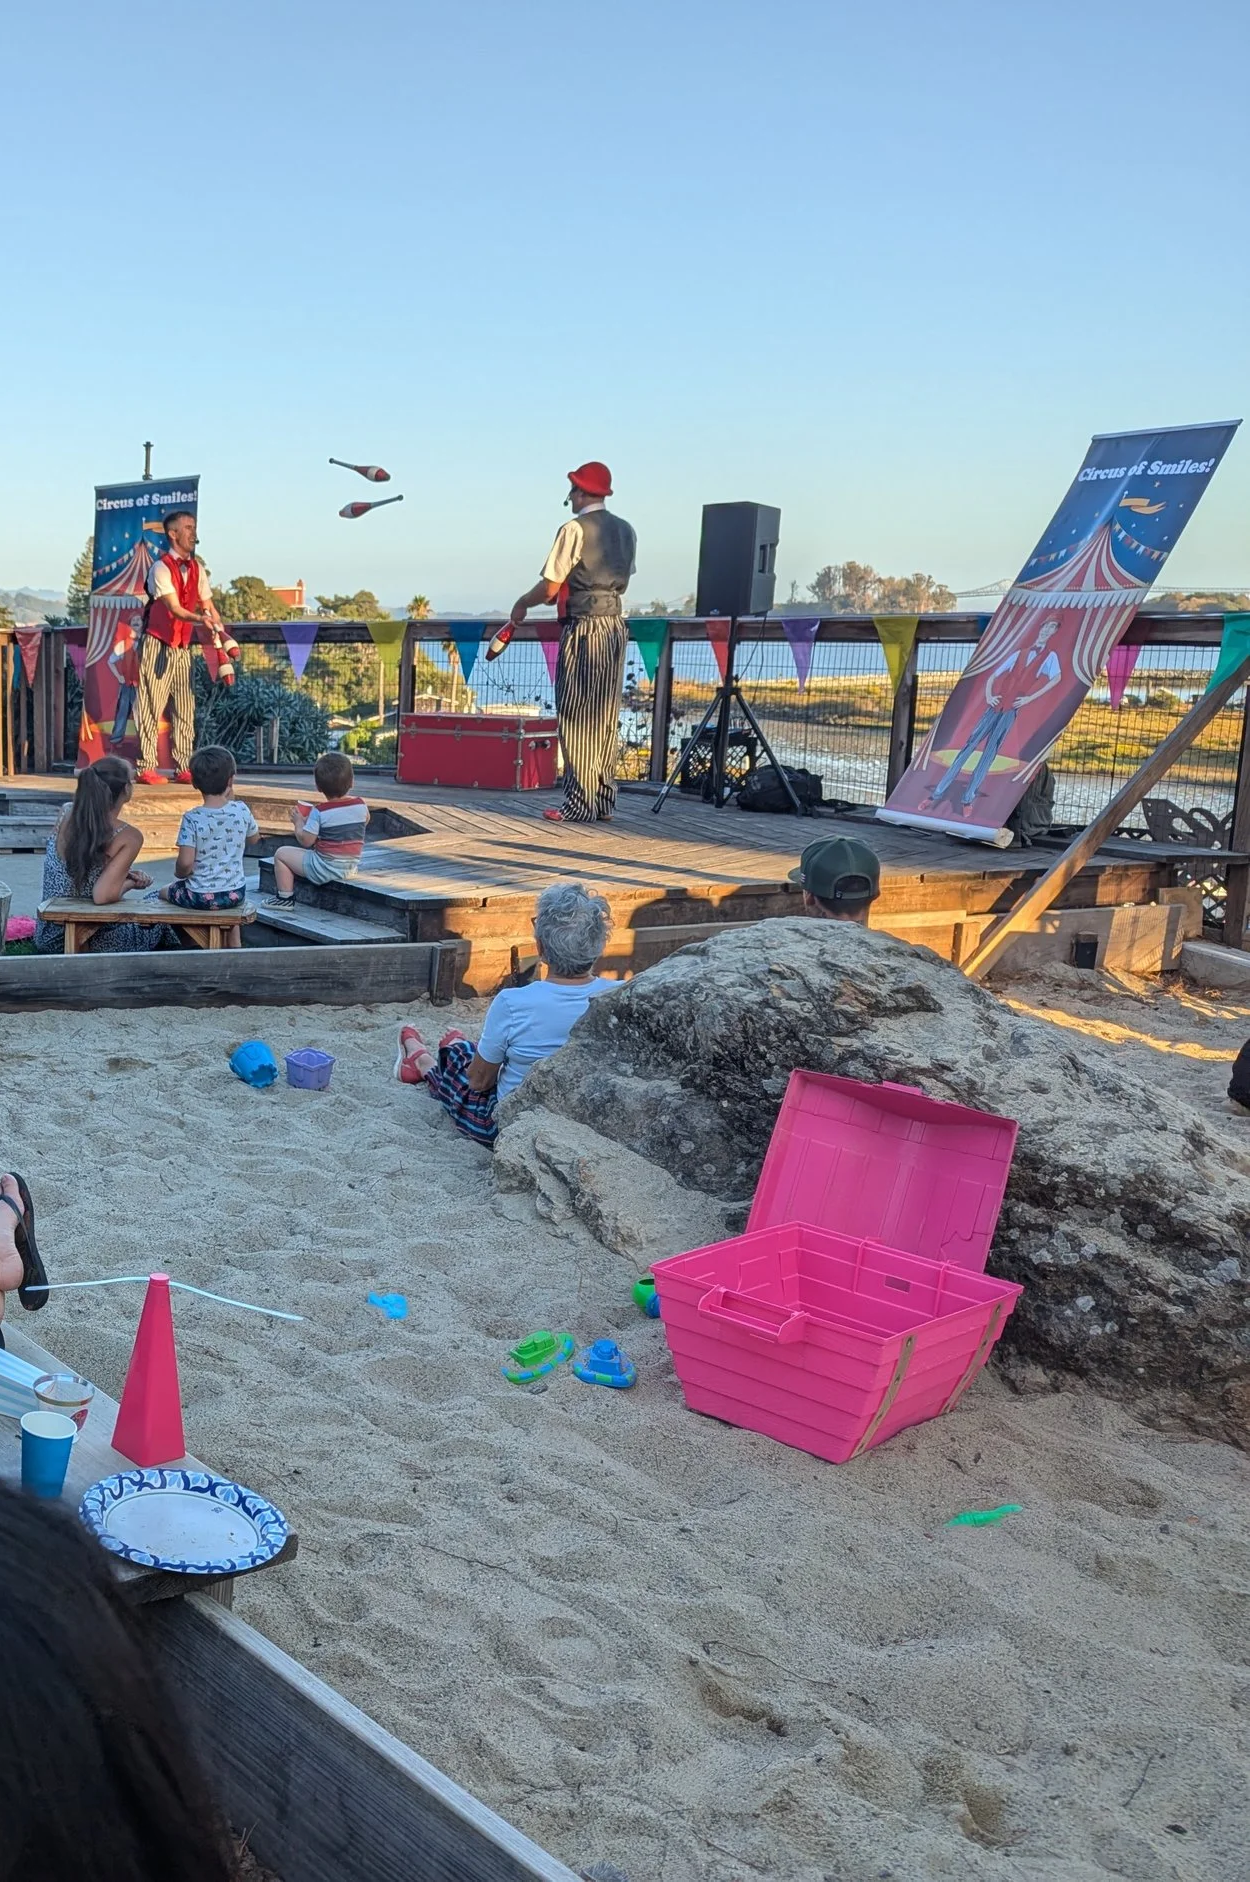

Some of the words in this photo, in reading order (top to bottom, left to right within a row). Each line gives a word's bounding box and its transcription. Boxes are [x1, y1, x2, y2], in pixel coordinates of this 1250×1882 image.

[1078, 467, 1126, 481] Circus
[1127, 461, 1148, 475] of
[1147, 458, 1215, 475] Smiles!
[96, 498, 134, 511] Circus
[135, 494, 150, 507] of
[151, 490, 198, 505] Smiles!
